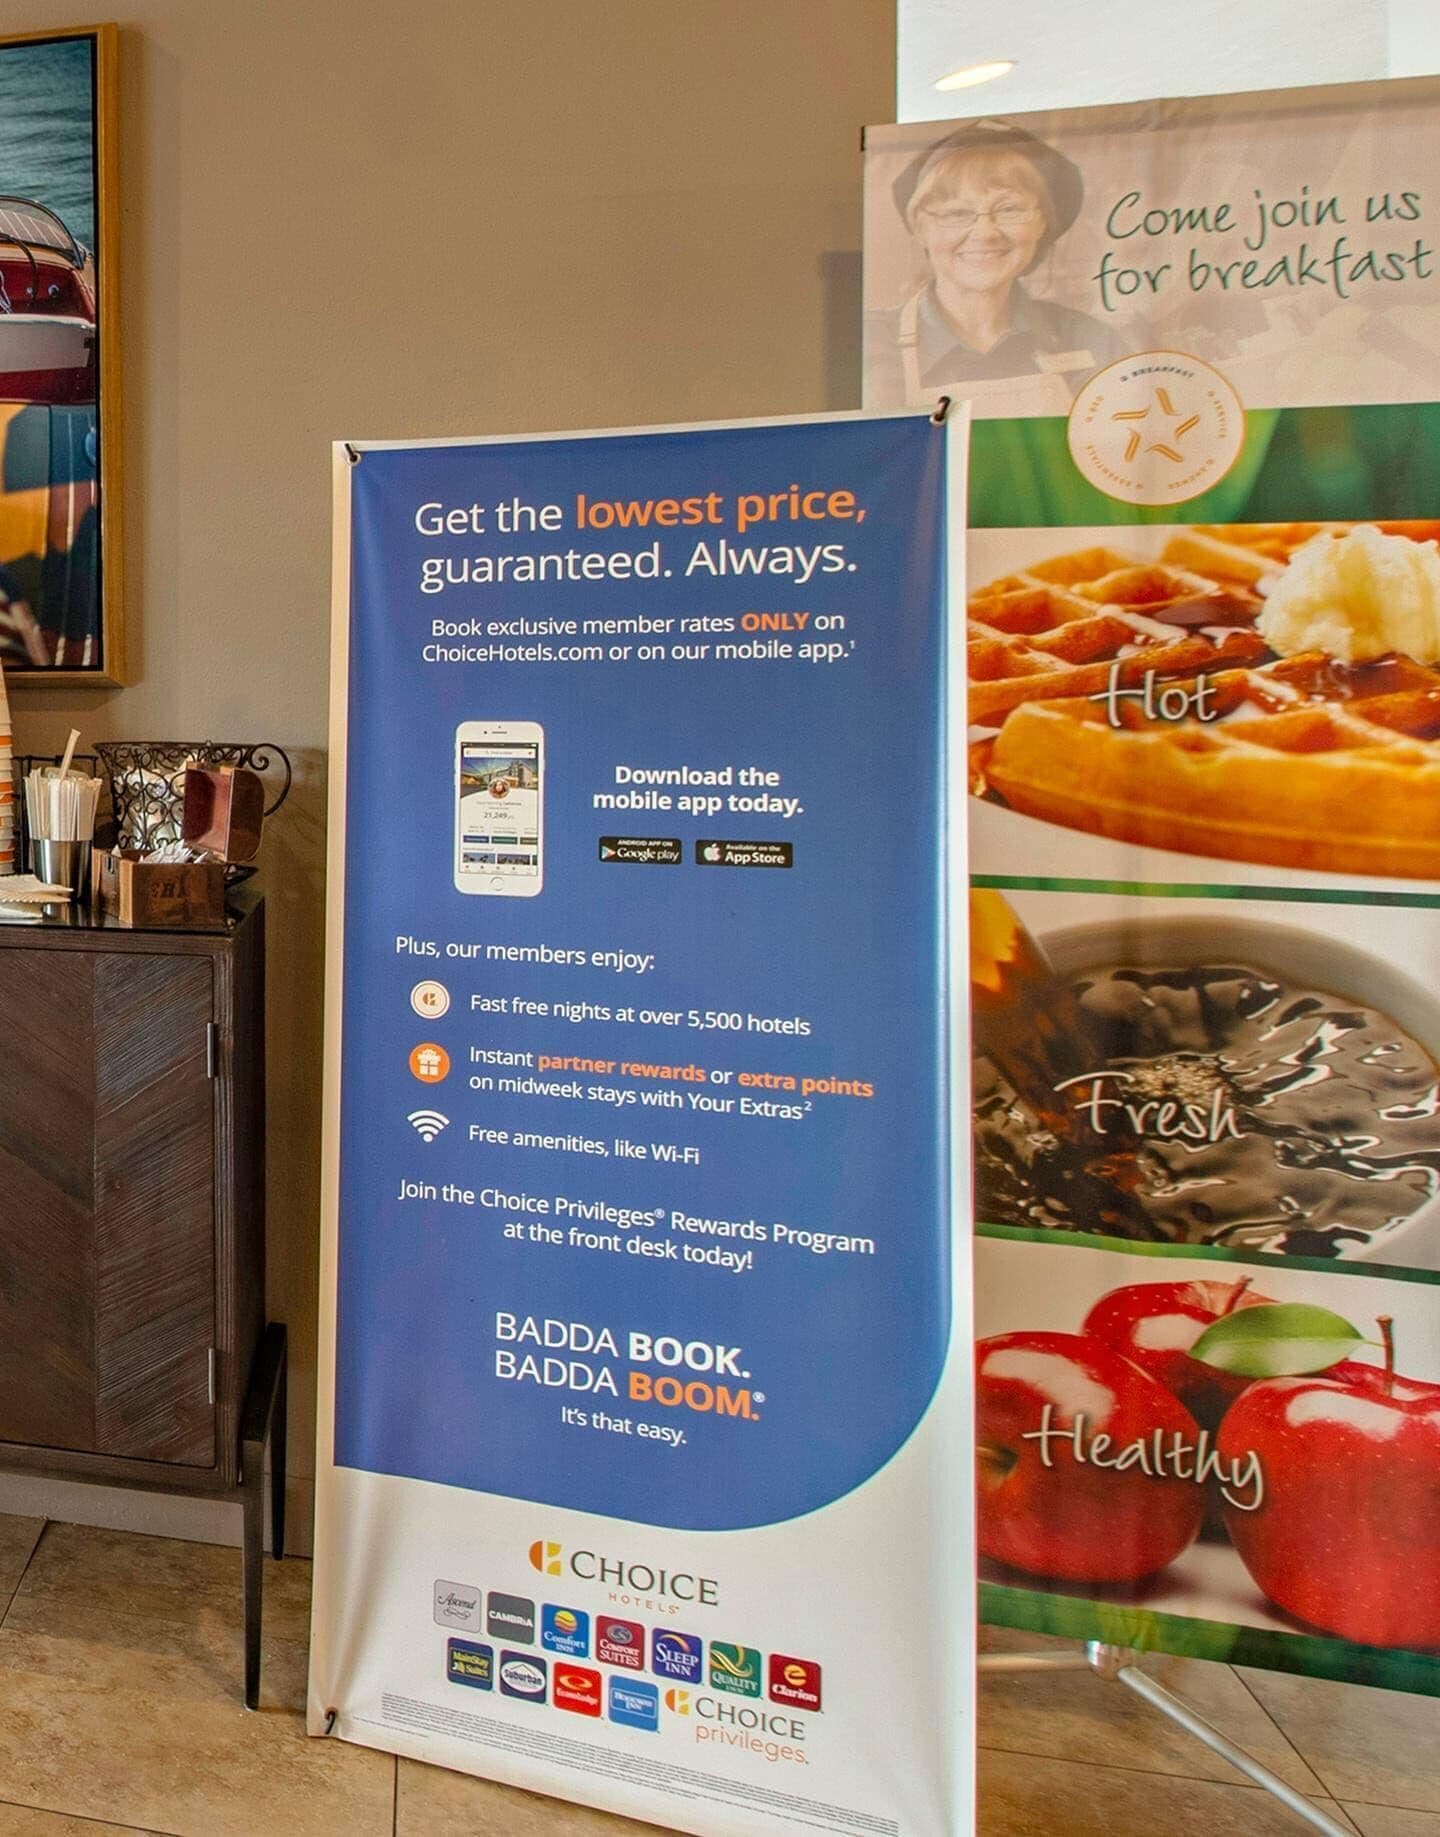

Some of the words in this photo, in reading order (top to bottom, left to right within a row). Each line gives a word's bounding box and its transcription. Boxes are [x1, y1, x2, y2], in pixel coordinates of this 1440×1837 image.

[1106, 191, 1237, 239] Come
[1244, 186, 1346, 251] join
[1365, 191, 1422, 222] us
[1092, 252, 1172, 312] for
[1189, 236, 1433, 299] breakfast
[415, 502, 486, 536] Get
[495, 497, 563, 533] the
[576, 490, 724, 530] lowest
[737, 483, 867, 533] price,
[420, 541, 673, 594] guaranteed.
[684, 539, 858, 584] Always.
[431, 618, 483, 637] Book
[487, 617, 578, 636] exclusive
[582, 615, 675, 635] member
[680, 615, 735, 633] rates
[740, 612, 810, 632] ONLY
[814, 615, 846, 631] on
[422, 643, 603, 662] ChoiceHotels.com
[609, 646, 633, 661] or
[637, 645, 666, 661] on
[671, 644, 710, 661] our
[715, 640, 793, 660] mobile
[1088, 664, 1217, 727] Hot
[615, 766, 733, 786] Download
[737, 767, 780, 787] the
[592, 791, 673, 810] mobile
[677, 794, 722, 817] app
[727, 793, 804, 818] today.
[617, 847, 656, 862] Google
[656, 849, 680, 862] play
[725, 851, 751, 864] App
[751, 851, 786, 864] Store
[396, 936, 441, 959] Plus,
[446, 942, 481, 958] our
[486, 944, 586, 966] members
[591, 949, 655, 974] enjoy:
[471, 994, 508, 1013] Fast
[512, 997, 549, 1016] free
[553, 1001, 611, 1023] nights
[615, 1007, 635, 1023] at
[639, 1008, 683, 1026] over
[687, 1010, 742, 1031] 5,500
[747, 1014, 812, 1036] hotels
[470, 1046, 534, 1068] Instant
[537, 1053, 616, 1074] partner
[620, 1060, 707, 1083] rewards
[710, 1069, 733, 1085] or
[737, 1071, 796, 1091] extra
[800, 1076, 875, 1098] points
[469, 1075, 493, 1090] on
[498, 1077, 583, 1100] midweek
[587, 1085, 637, 1107] stays
[640, 1090, 684, 1108] with
[688, 1093, 735, 1114] Your
[1053, 1071, 1246, 1142] Fresh
[469, 1125, 509, 1144] Free
[512, 1131, 609, 1158] amenities,
[614, 1139, 647, 1160] like
[651, 1143, 701, 1165] Wi-Fi
[398, 1179, 437, 1200] Join
[441, 1184, 475, 1205] the
[480, 1189, 550, 1214] Choice
[671, 1211, 768, 1241] Rewards
[772, 1224, 876, 1255] Program
[503, 1222, 524, 1240] at
[528, 1222, 563, 1245] the
[568, 1227, 621, 1252] front
[625, 1235, 678, 1260] desk
[683, 1245, 753, 1273] today!
[495, 1311, 620, 1358] BADDA
[628, 1332, 752, 1379] BOOK.
[495, 1350, 619, 1397] BADDA
[561, 1406, 588, 1427] It's
[591, 1411, 633, 1436] that
[636, 1422, 688, 1448] easy.
[1022, 1403, 1264, 1511] Healthy
[570, 1550, 720, 1606] CHOICE
[543, 1631, 586, 1650] Comfort
[599, 1650, 640, 1667] SUITES
[655, 1643, 700, 1667] SLEEP
[504, 1668, 543, 1686] Suburban
[665, 1662, 692, 1677] INN
[711, 1671, 759, 1691] QUALITY
[771, 1684, 819, 1703] Clarion
[695, 1697, 806, 1741] CHOICE
